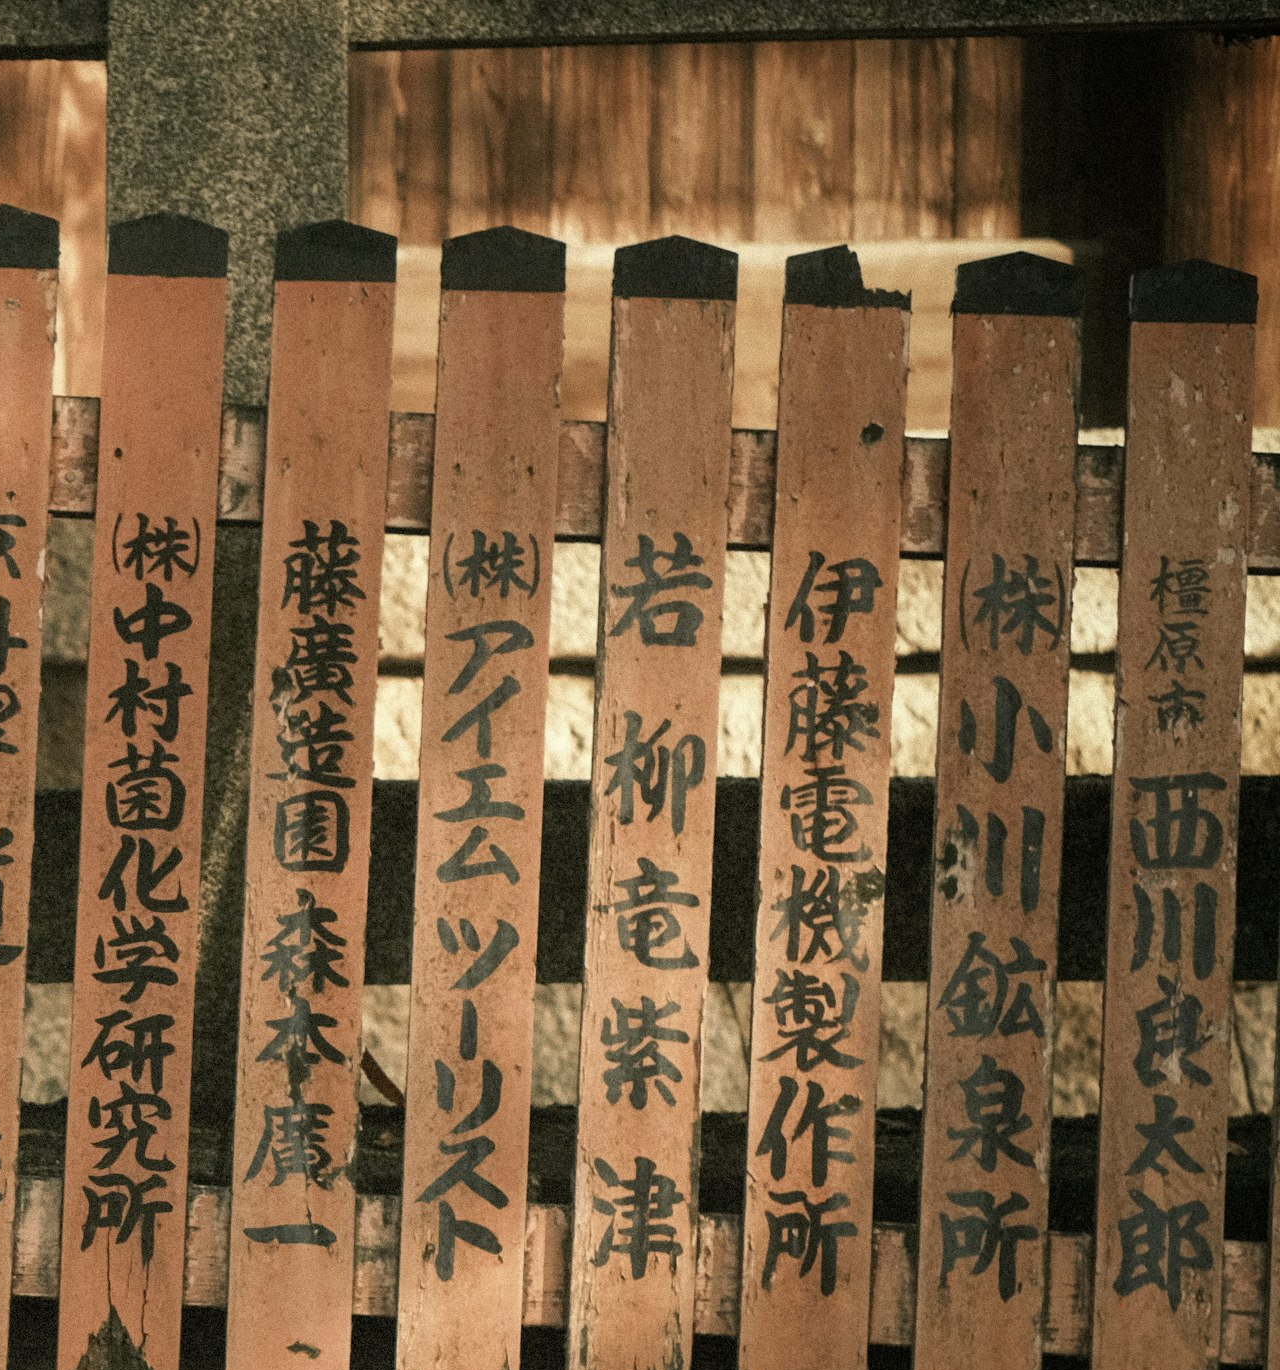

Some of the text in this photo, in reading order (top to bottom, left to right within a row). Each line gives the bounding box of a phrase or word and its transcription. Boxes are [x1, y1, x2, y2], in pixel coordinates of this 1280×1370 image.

[754, 550, 883, 1297] 伊藤電機製作所
